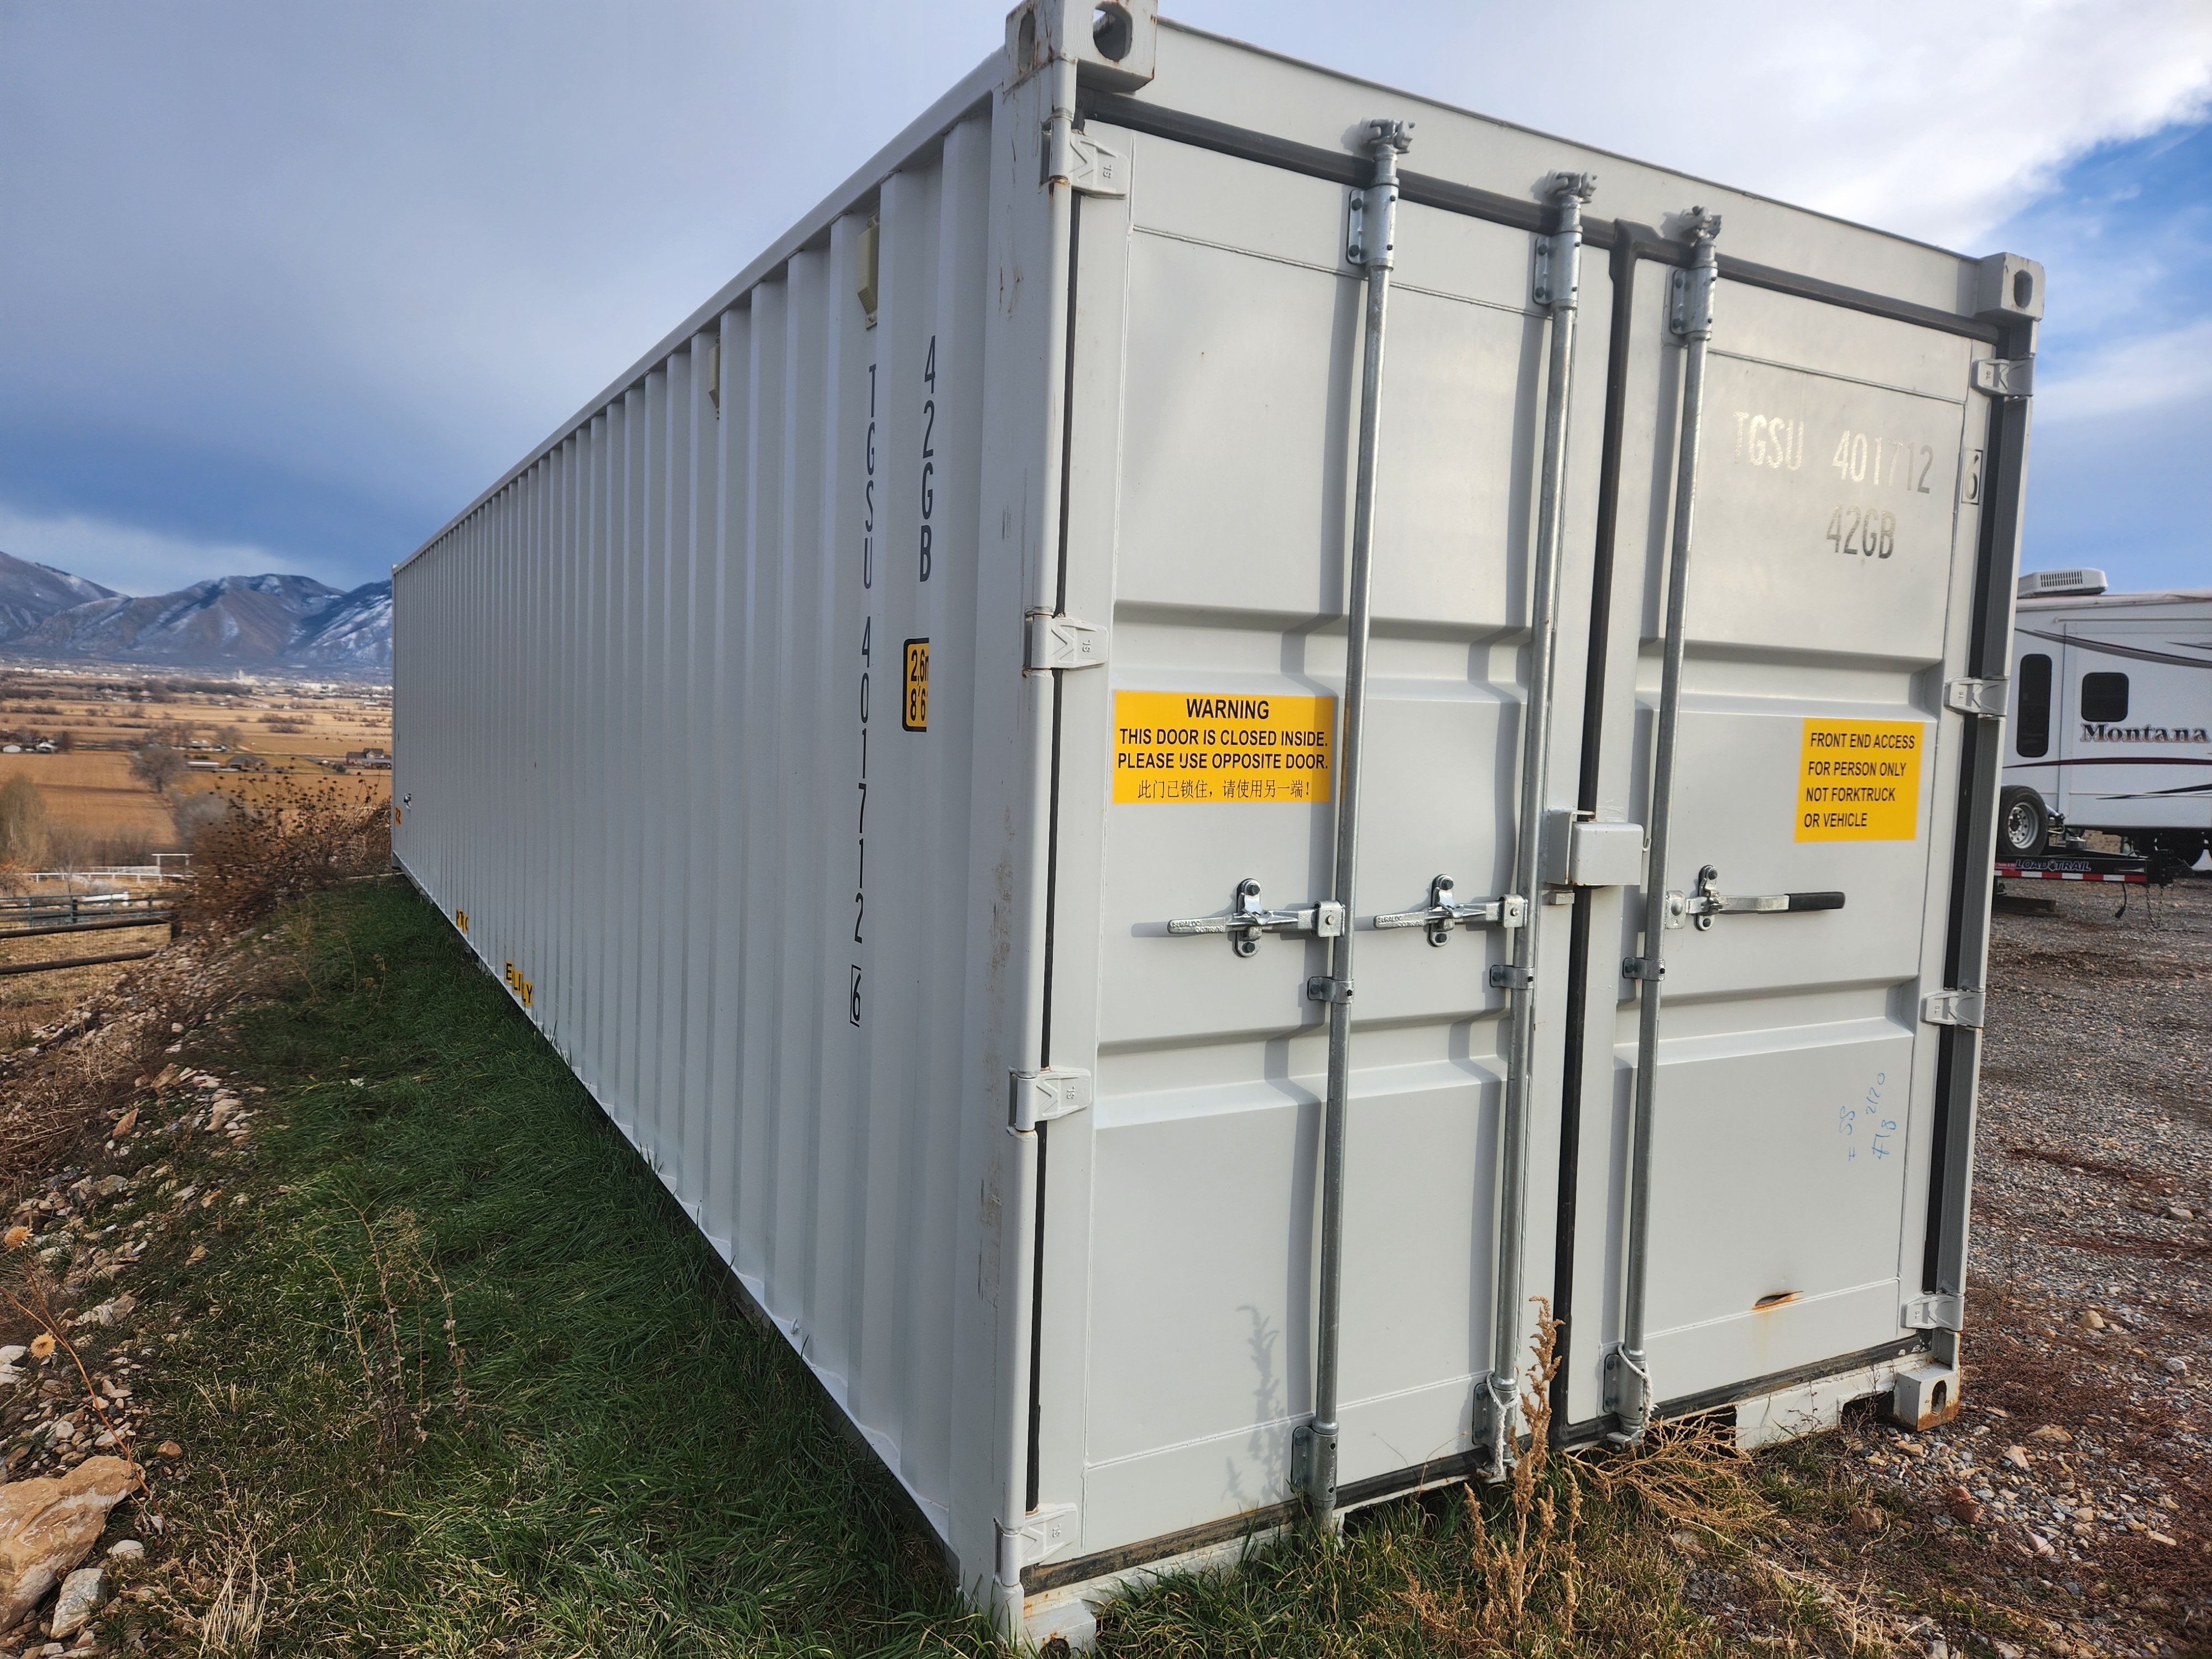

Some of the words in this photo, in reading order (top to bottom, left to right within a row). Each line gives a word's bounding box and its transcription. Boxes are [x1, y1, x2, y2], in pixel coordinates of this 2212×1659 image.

[920, 335, 936, 582] 42GB
[1732, 411, 1804, 471] TGSU
[1832, 430, 1934, 494] 401712
[1965, 454, 1979, 500] 6
[864, 363, 877, 589] TGSU
[1826, 504, 1897, 559] 42GB
[1186, 698, 1269, 719] WARNING
[1119, 728, 1151, 744] THIS
[1156, 729, 1199, 745] DOOR
[1203, 729, 1215, 745] IS
[1220, 730, 1277, 746] CLOSED
[1281, 731, 1328, 747] INSIDE.
[1811, 732, 1847, 747] FRONT
[1850, 734, 1871, 748] END
[1873, 734, 1915, 749] ACCESS
[2080, 722, 2211, 743] Montana
[1118, 753, 1173, 768] PLEASE
[1180, 753, 1207, 768] USE
[1212, 753, 1281, 769] OPPOSITE
[1286, 754, 1328, 769] DOOR.
[1808, 761, 1830, 775] FOR
[1834, 761, 1877, 776] PERSON
[1880, 762, 1907, 776] ONLY
[854, 616, 870, 944] 401712
[1806, 787, 1829, 801] NOT
[1832, 787, 1896, 801] FORKTRUCK
[1804, 813, 1820, 827] OR
[1824, 813, 1867, 827] VEHICLE
[2016, 859, 2048, 869] LOAD
[2056, 860, 2091, 872] TRAIL
[853, 973, 862, 1022] 6
